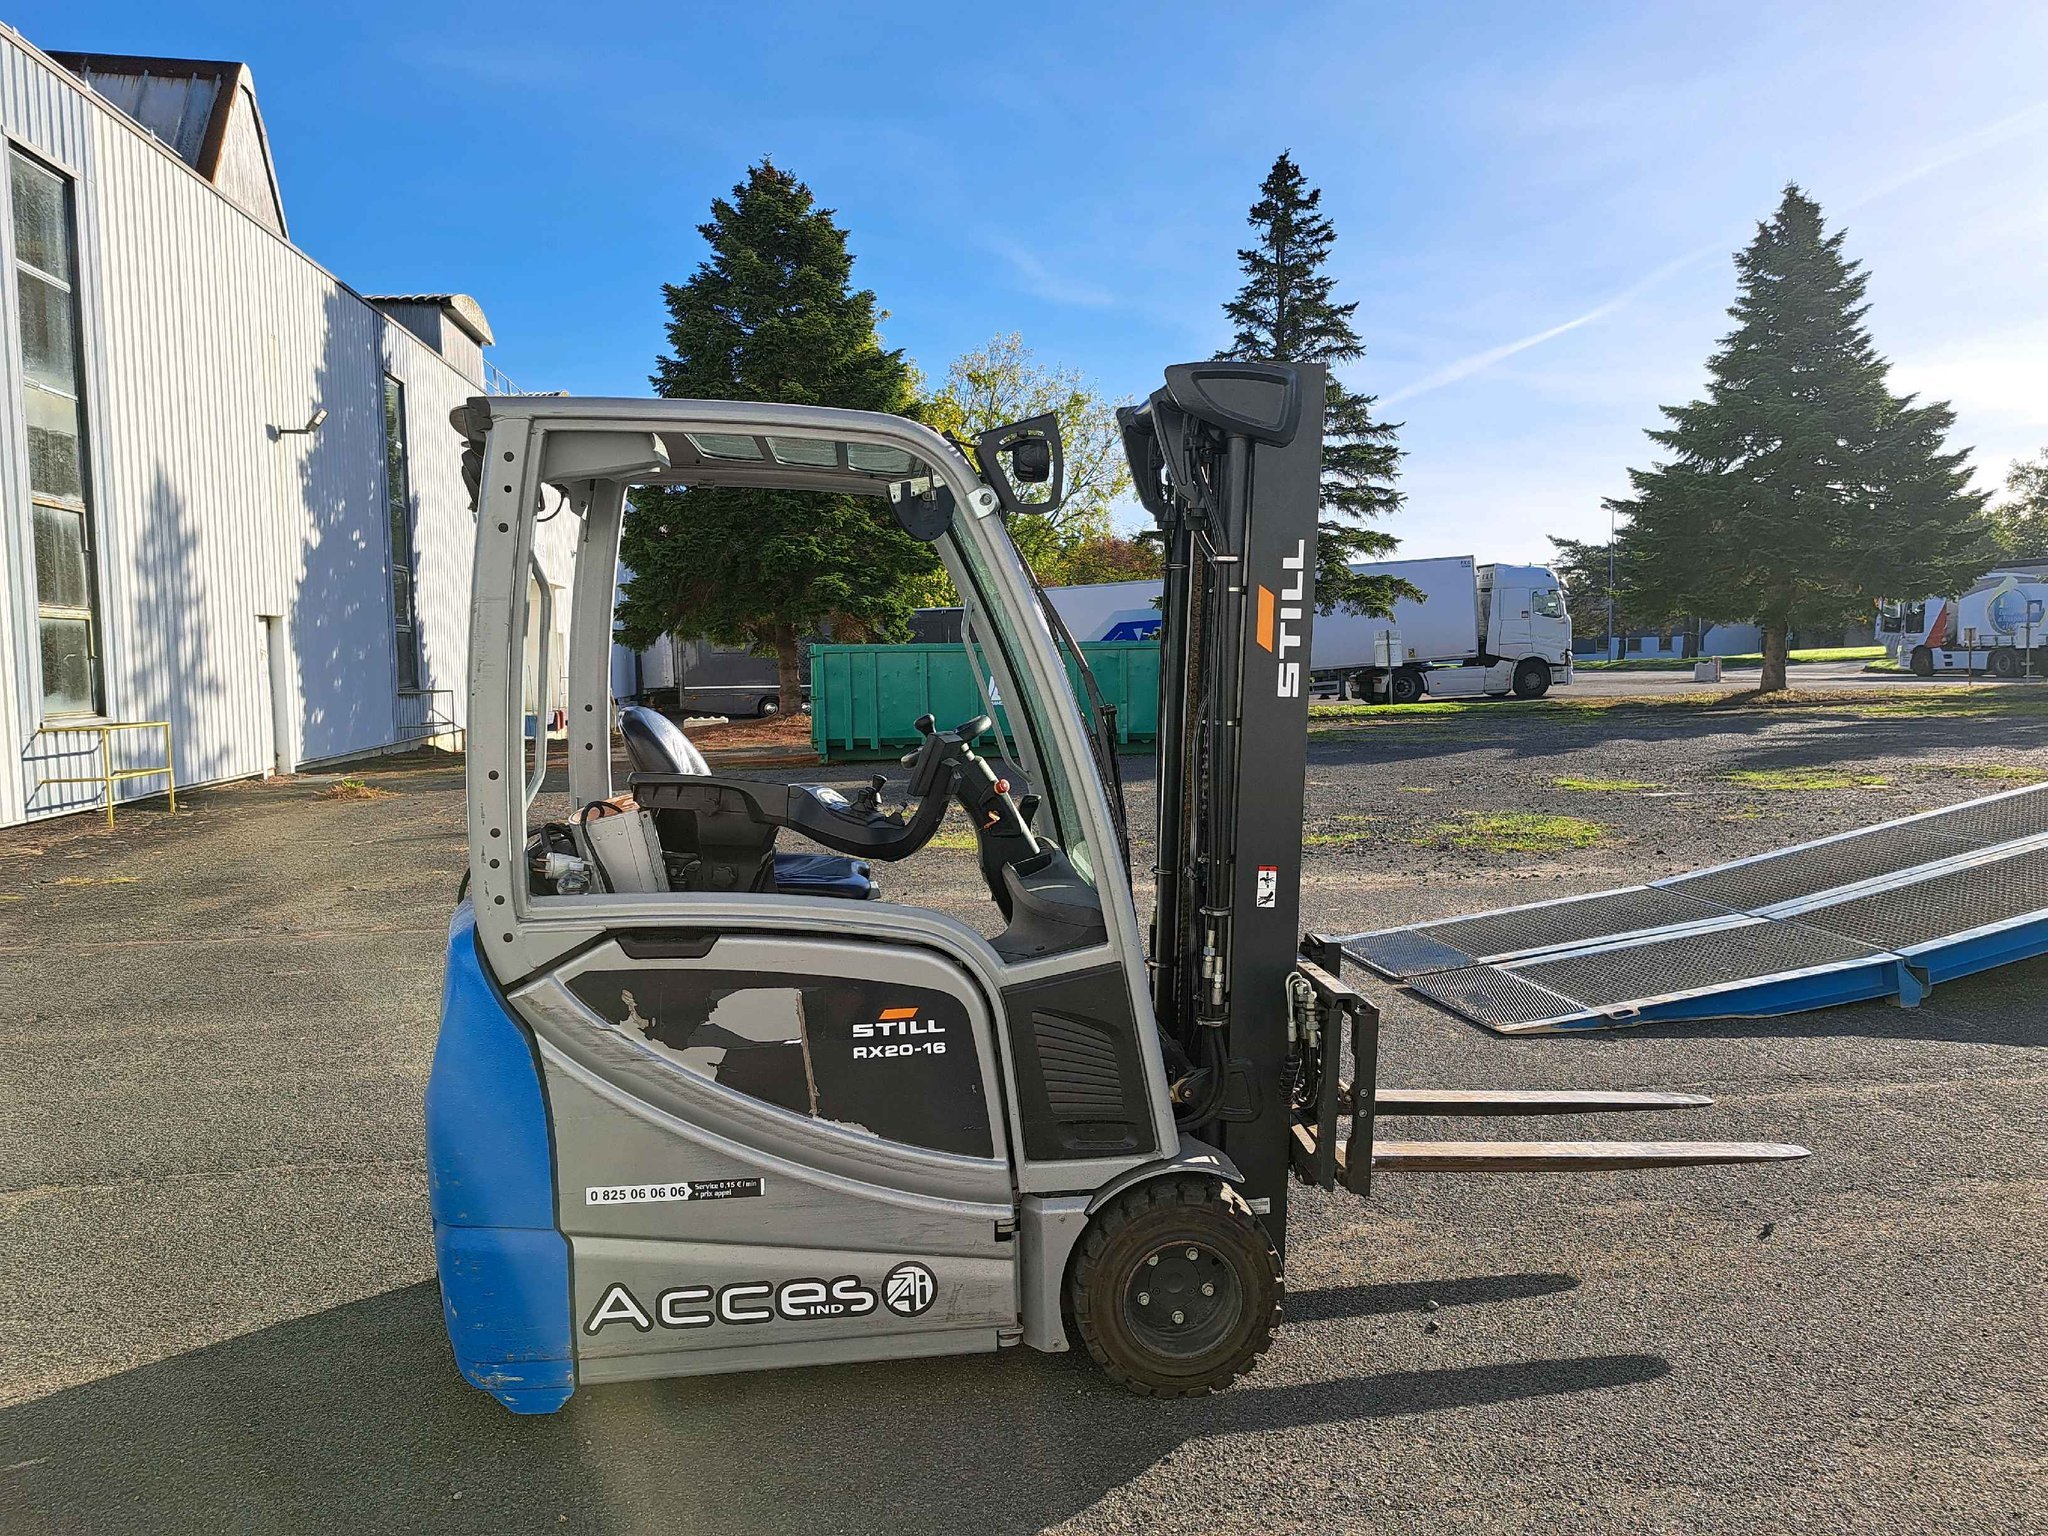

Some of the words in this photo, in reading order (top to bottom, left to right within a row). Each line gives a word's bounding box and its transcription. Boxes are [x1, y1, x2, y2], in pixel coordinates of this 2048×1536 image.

[1277, 539, 1305, 698] STILL
[853, 1020, 946, 1038] STILL
[853, 1042, 947, 1059] RX20-16
[590, 1190, 598, 1201] 0
[602, 1190, 626, 1201] 825
[630, 1188, 646, 1200] 06
[650, 1187, 666, 1199] 06
[670, 1186, 686, 1198] 06
[700, 1190, 713, 1199] prix
[810, 1304, 845, 1315] IND
